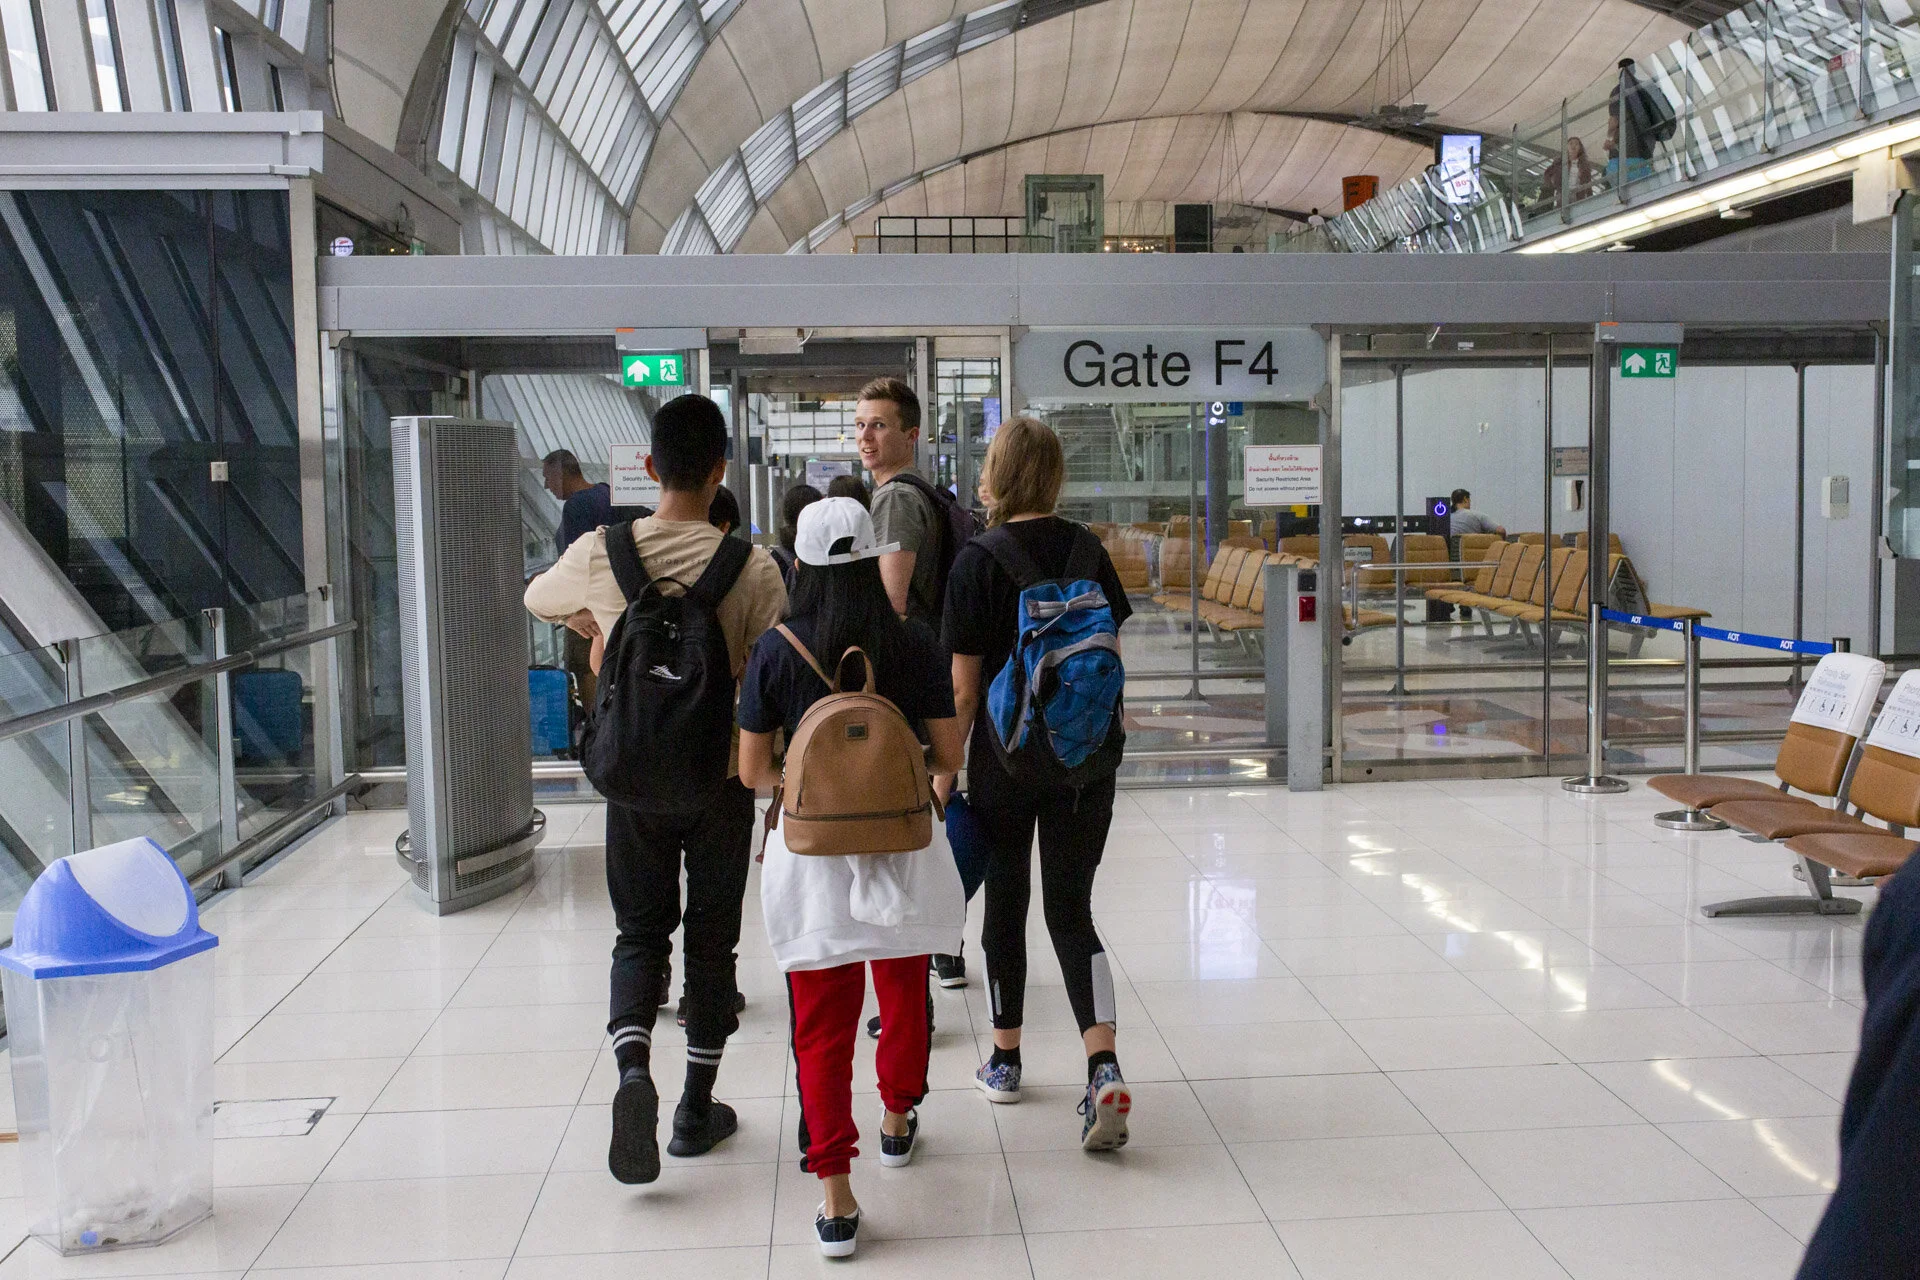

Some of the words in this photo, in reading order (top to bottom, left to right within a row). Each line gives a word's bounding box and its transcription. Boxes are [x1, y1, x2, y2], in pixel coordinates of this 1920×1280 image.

[1063, 340, 1191, 388] Gate
[1215, 339, 1279, 386] F4
[1631, 615, 1642, 624] AOT
[1727, 632, 1740, 642] AOT
[1779, 640, 1794, 650] AOT
